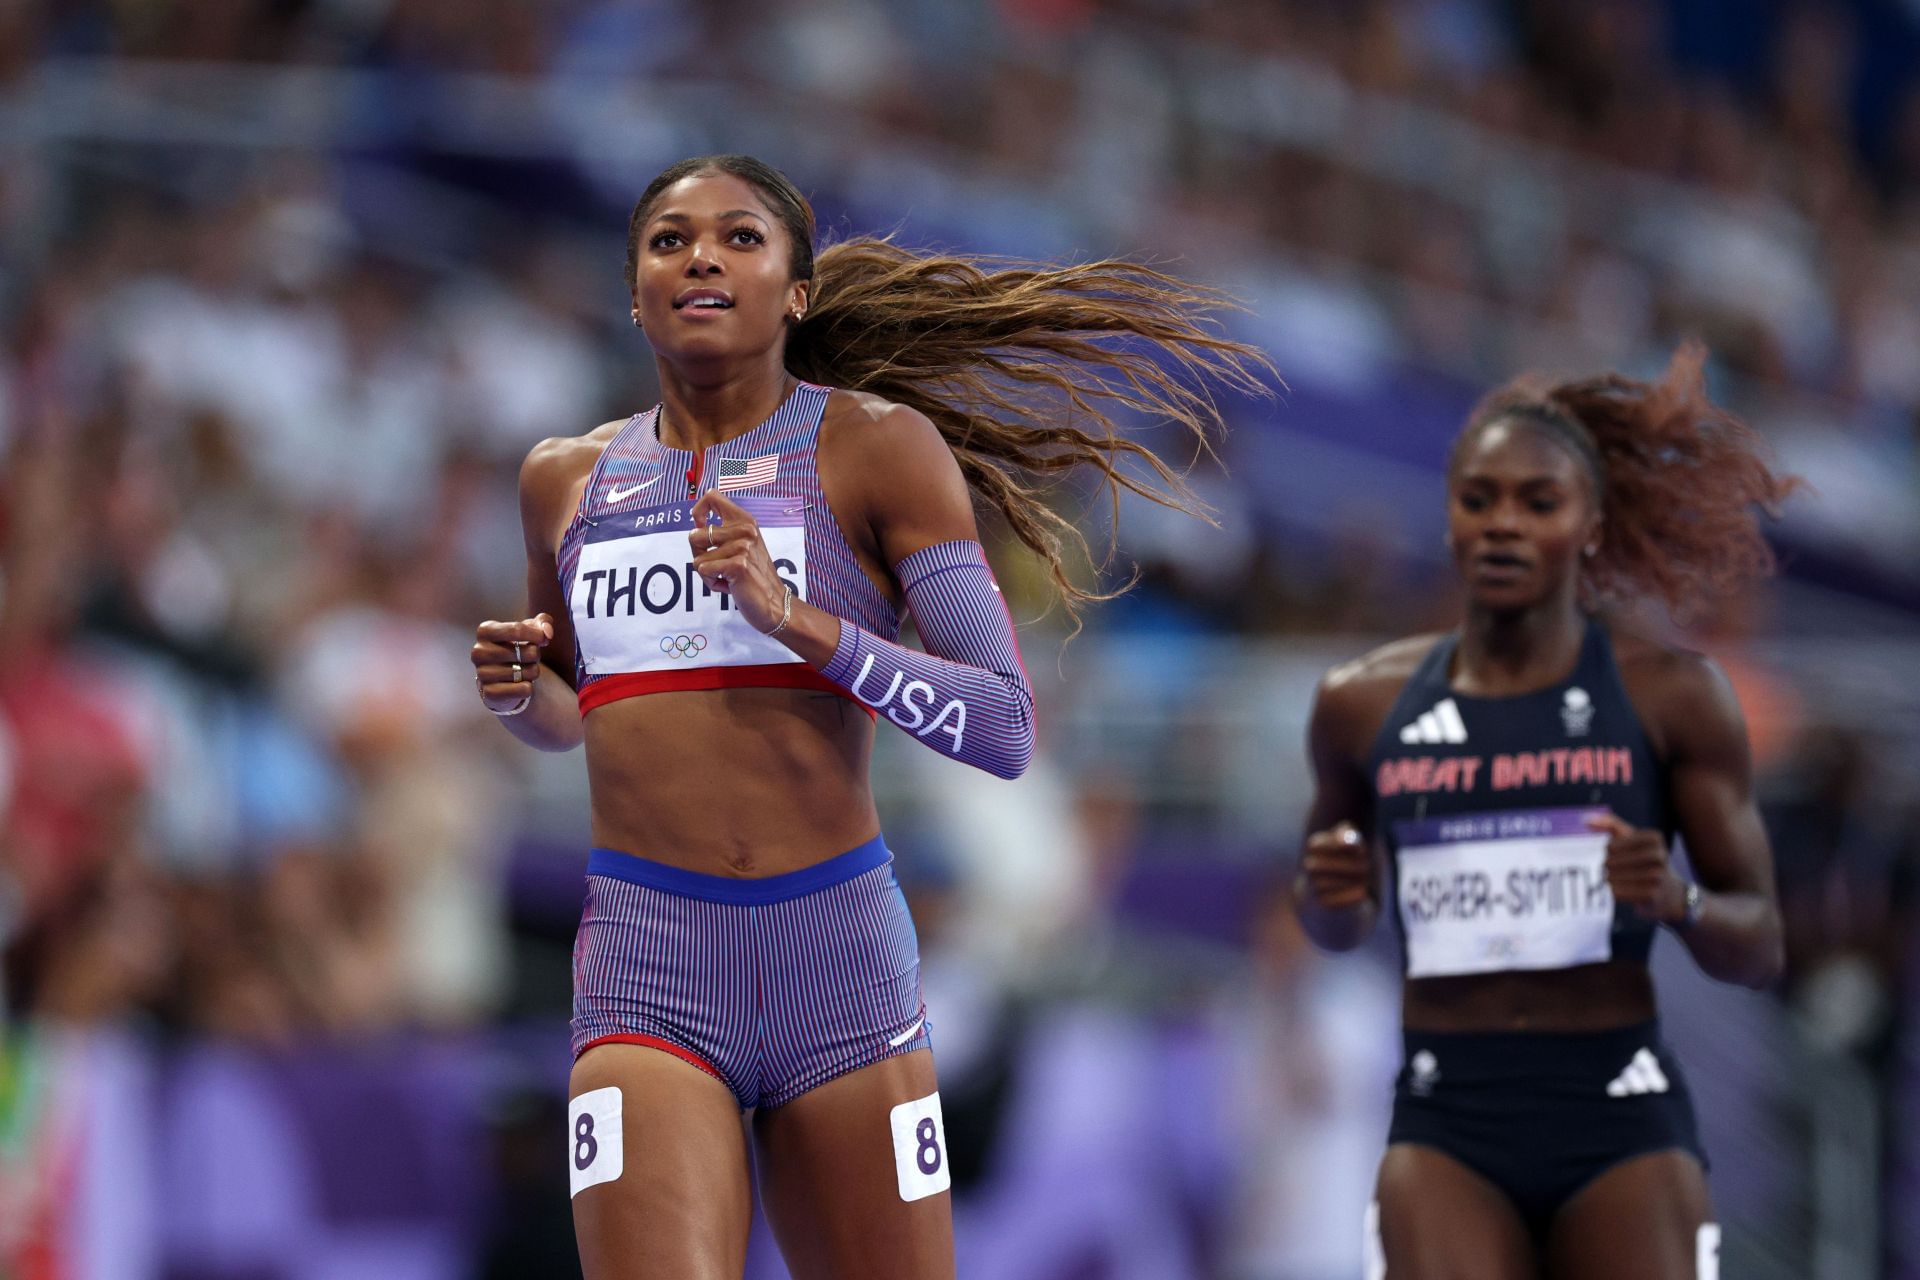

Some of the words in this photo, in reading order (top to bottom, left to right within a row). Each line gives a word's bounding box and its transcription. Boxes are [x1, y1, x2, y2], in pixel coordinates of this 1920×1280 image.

[634, 508, 682, 529] PARIS
[582, 559, 800, 619] THOMS
[851, 653, 967, 753] USA
[1376, 755, 1483, 797] GREAT
[1490, 746, 1634, 791] BRITAIN
[574, 1112, 598, 1171] 8
[915, 1117, 942, 1176] 8
